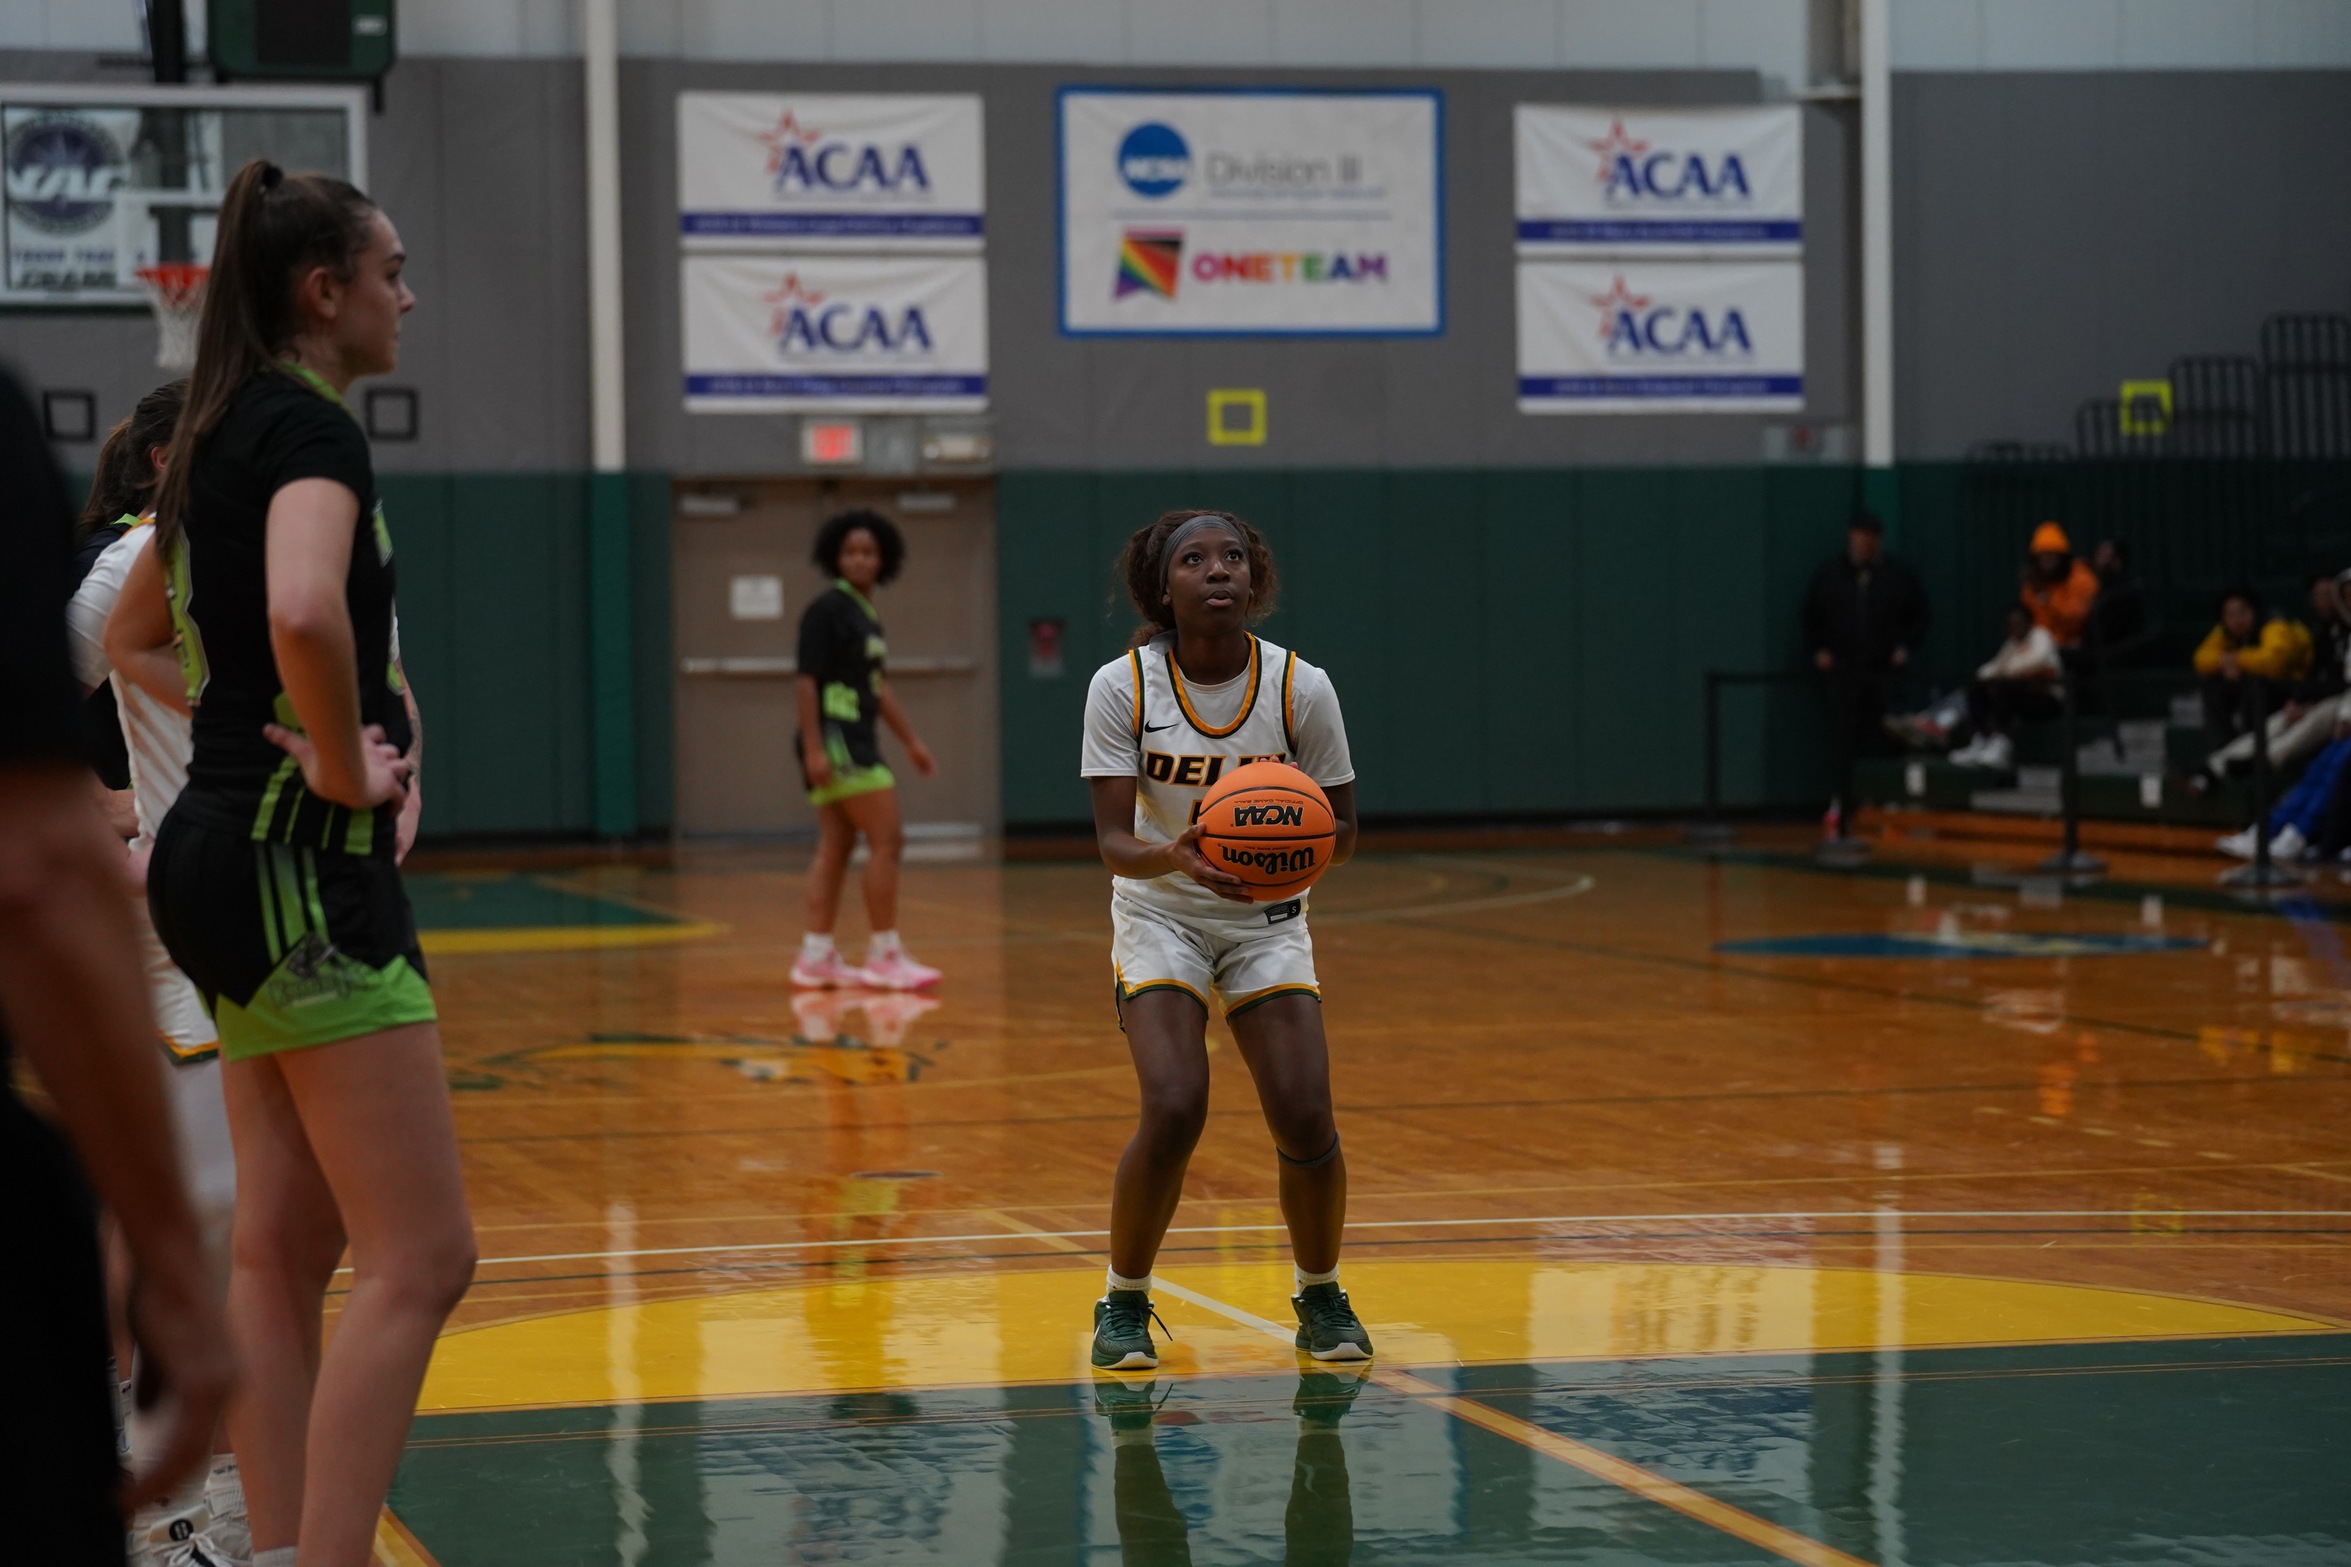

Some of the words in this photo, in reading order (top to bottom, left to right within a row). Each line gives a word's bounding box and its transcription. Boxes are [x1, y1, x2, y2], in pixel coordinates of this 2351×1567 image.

[776, 144, 930, 191] ACAA
[1206, 152, 1329, 186] Division
[1608, 153, 1750, 198] ACAA
[781, 304, 933, 351] ACAA
[1610, 307, 1751, 355] ACAA
[1145, 750, 1287, 787] DEL
[1234, 805, 1304, 828] NCAA
[1221, 845, 1315, 876] Wilson
